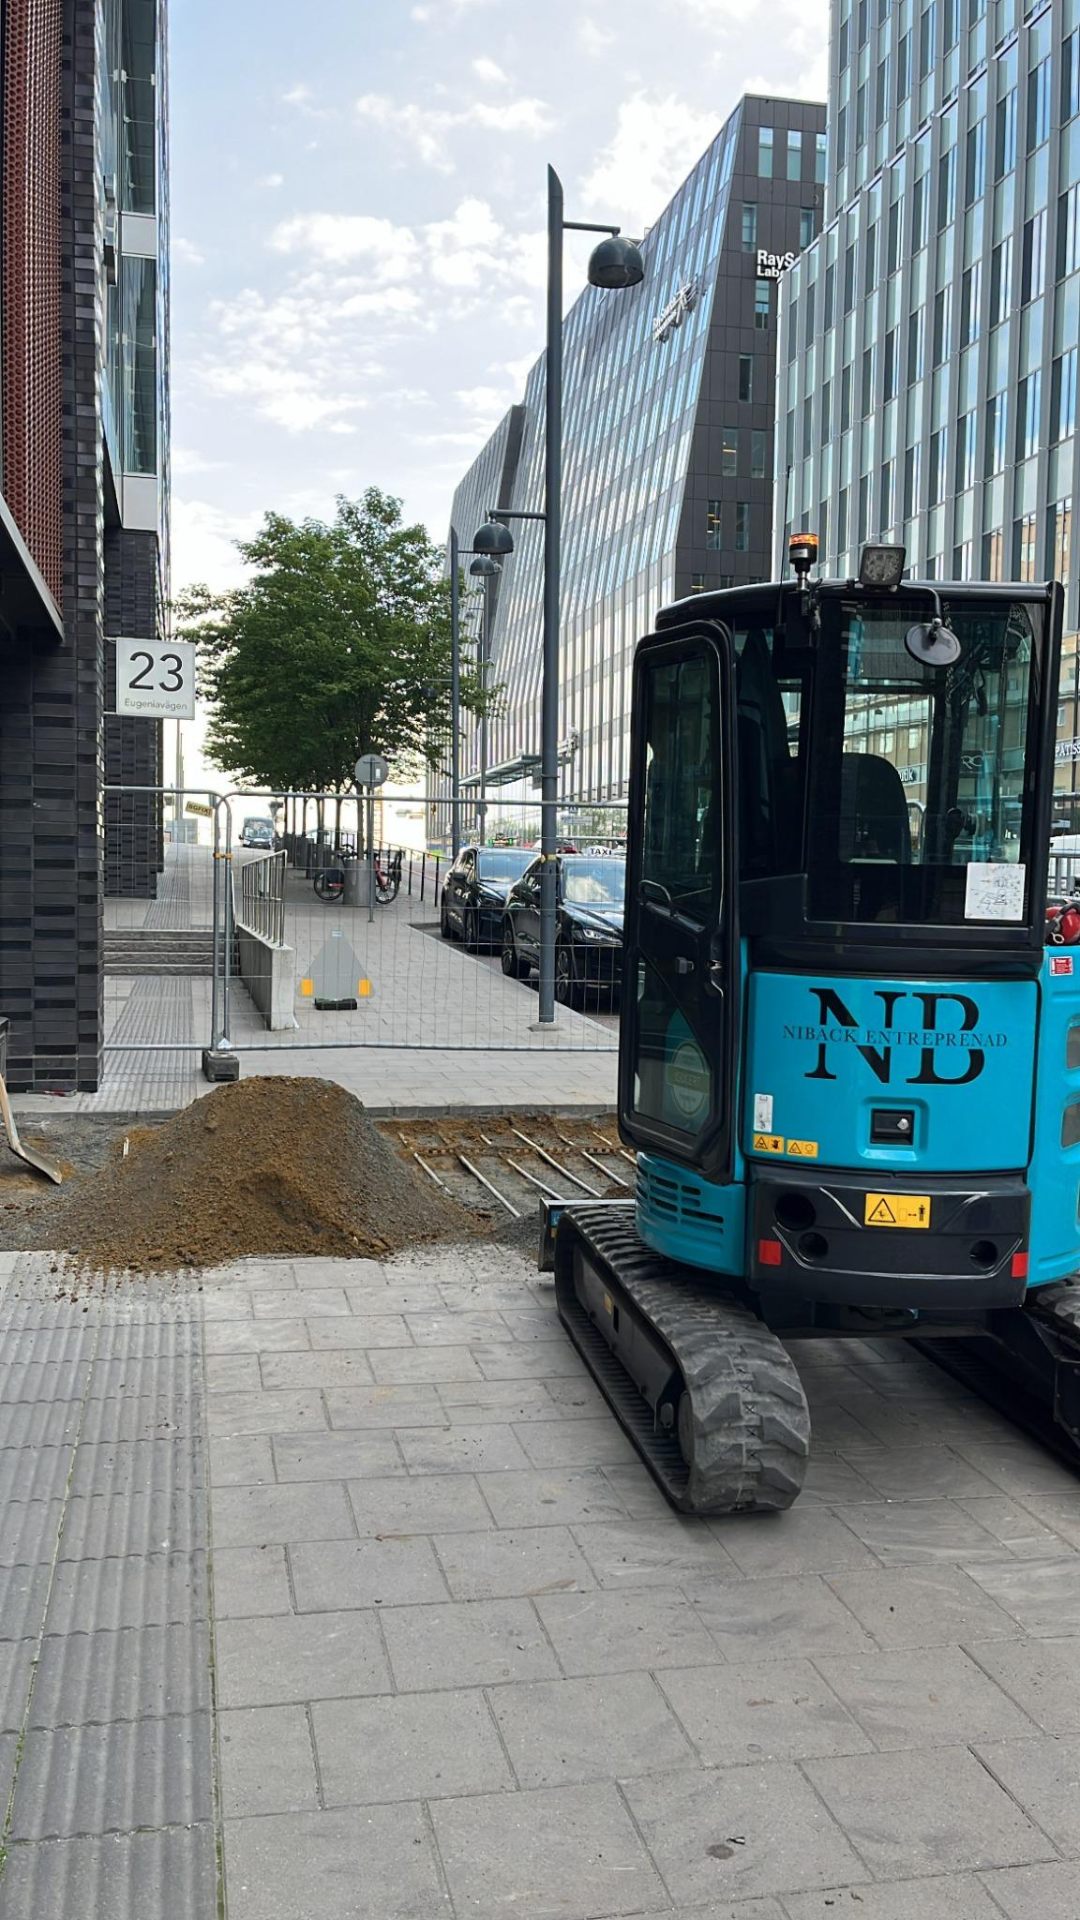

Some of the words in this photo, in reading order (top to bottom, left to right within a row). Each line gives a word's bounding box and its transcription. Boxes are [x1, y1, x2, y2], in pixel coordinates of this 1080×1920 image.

[757, 249, 795, 269] RayS
[757, 265, 780, 277] Lab
[129, 651, 183, 692] 23
[124, 698, 188, 711] Eugeniavägen
[590, 847, 612, 856] TAXI
[783, 1024, 857, 1043] NIBACK
[866, 1030, 1008, 1047] ENTREPRENAD
[804, 988, 985, 1084] NB
